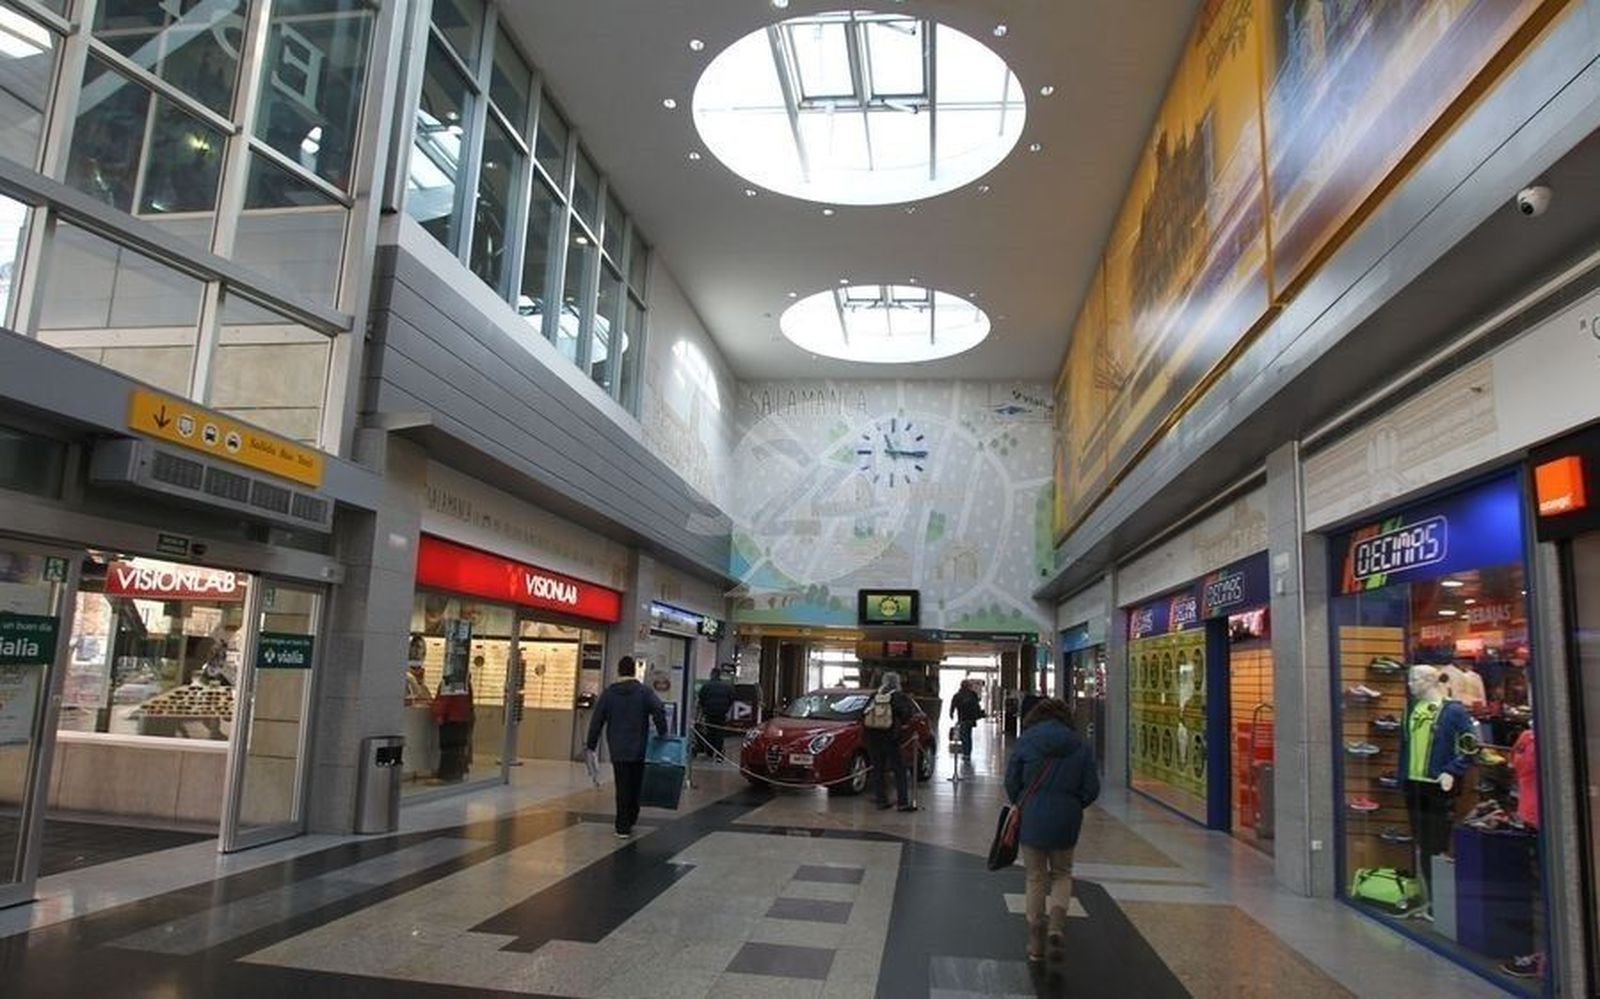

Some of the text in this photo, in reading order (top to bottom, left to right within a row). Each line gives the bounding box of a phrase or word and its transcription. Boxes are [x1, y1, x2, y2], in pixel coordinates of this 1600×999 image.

[1357, 523, 1439, 575] DECIMAS
[117, 568, 236, 592] VISIONLAB
[526, 573, 577, 605] VISIONLAB
